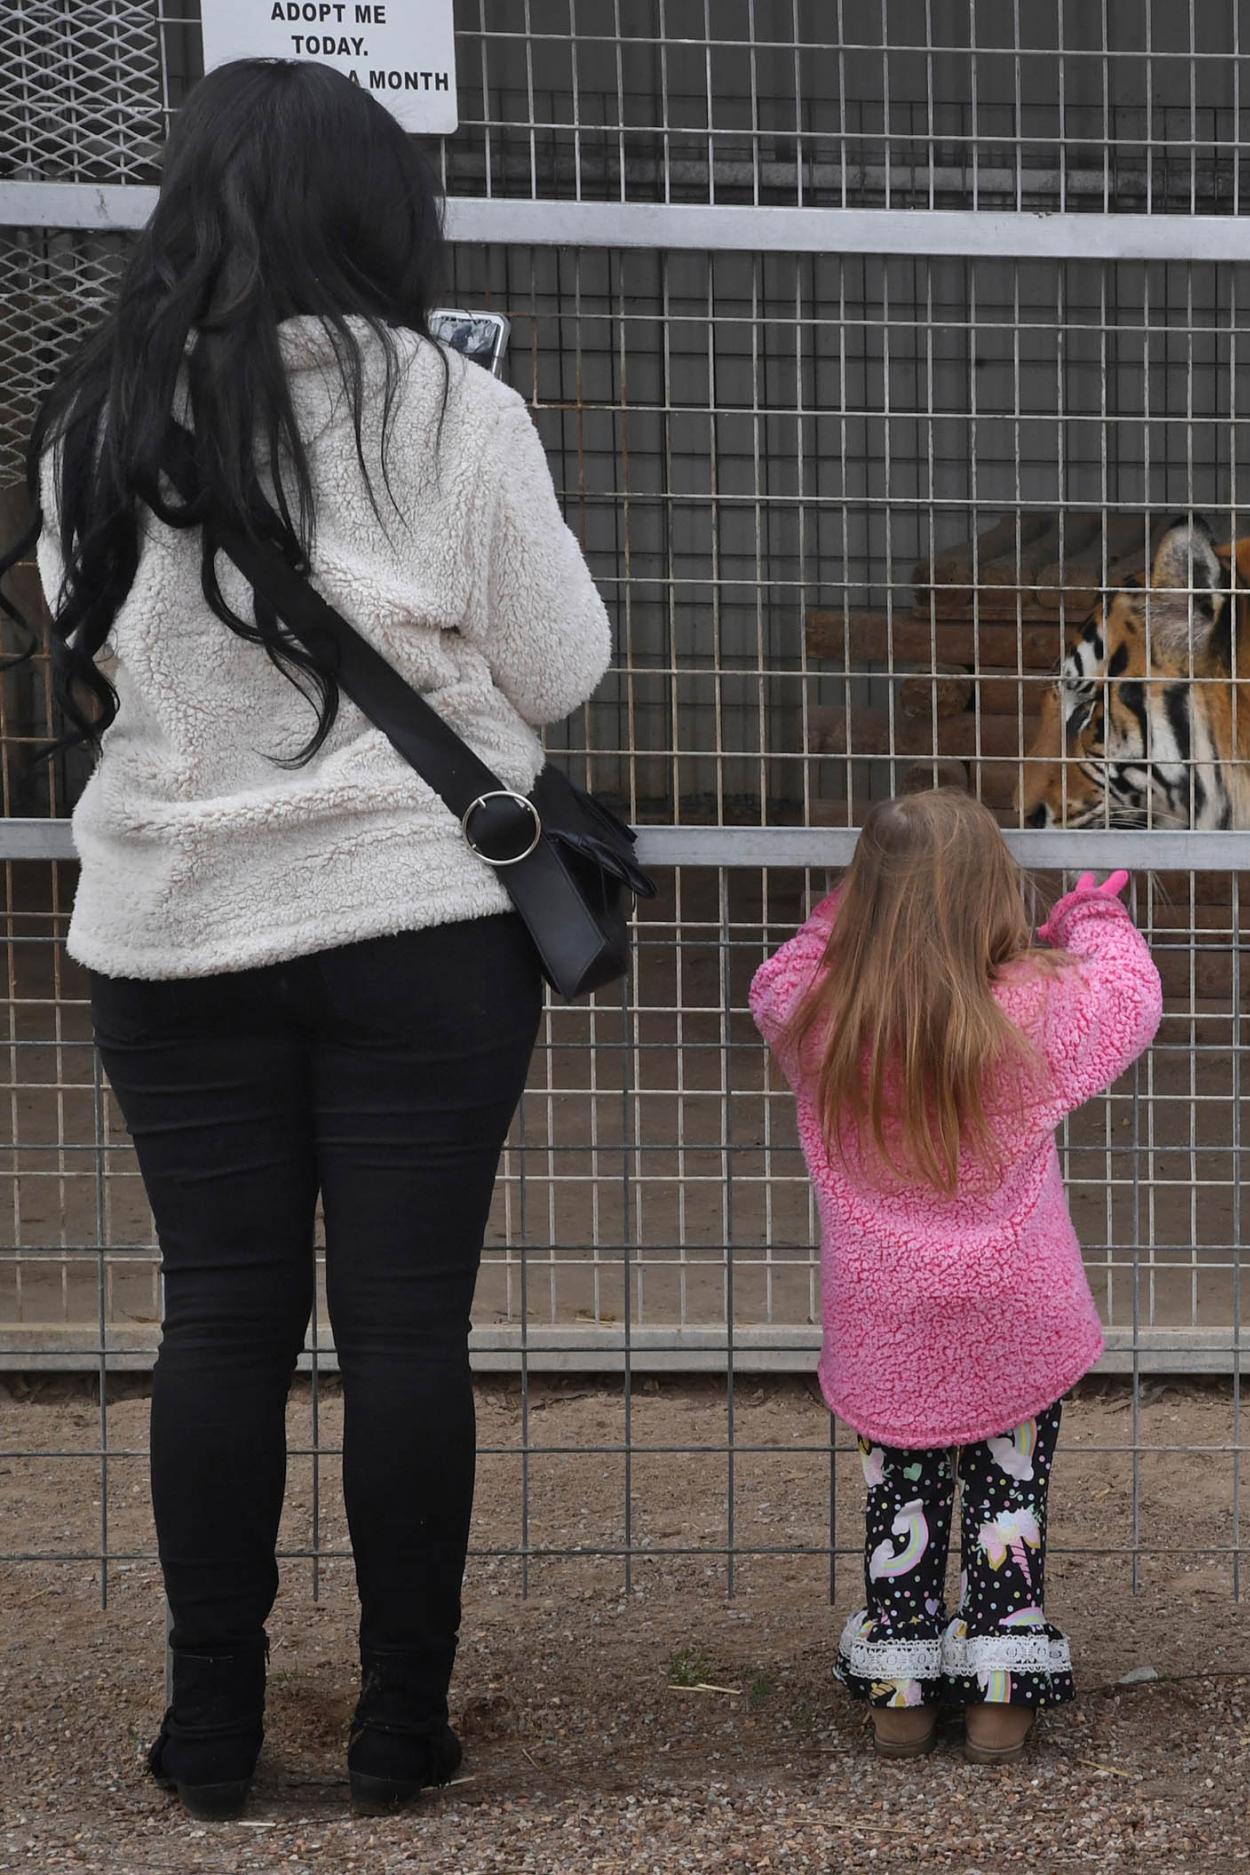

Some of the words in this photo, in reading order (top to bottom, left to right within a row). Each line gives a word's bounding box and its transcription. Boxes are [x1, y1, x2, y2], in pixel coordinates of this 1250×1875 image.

[271, 2, 345, 23] ADOPT
[355, 5, 386, 24] ME
[291, 35, 368, 56] TODAY.
[369, 70, 448, 91] MONTH
